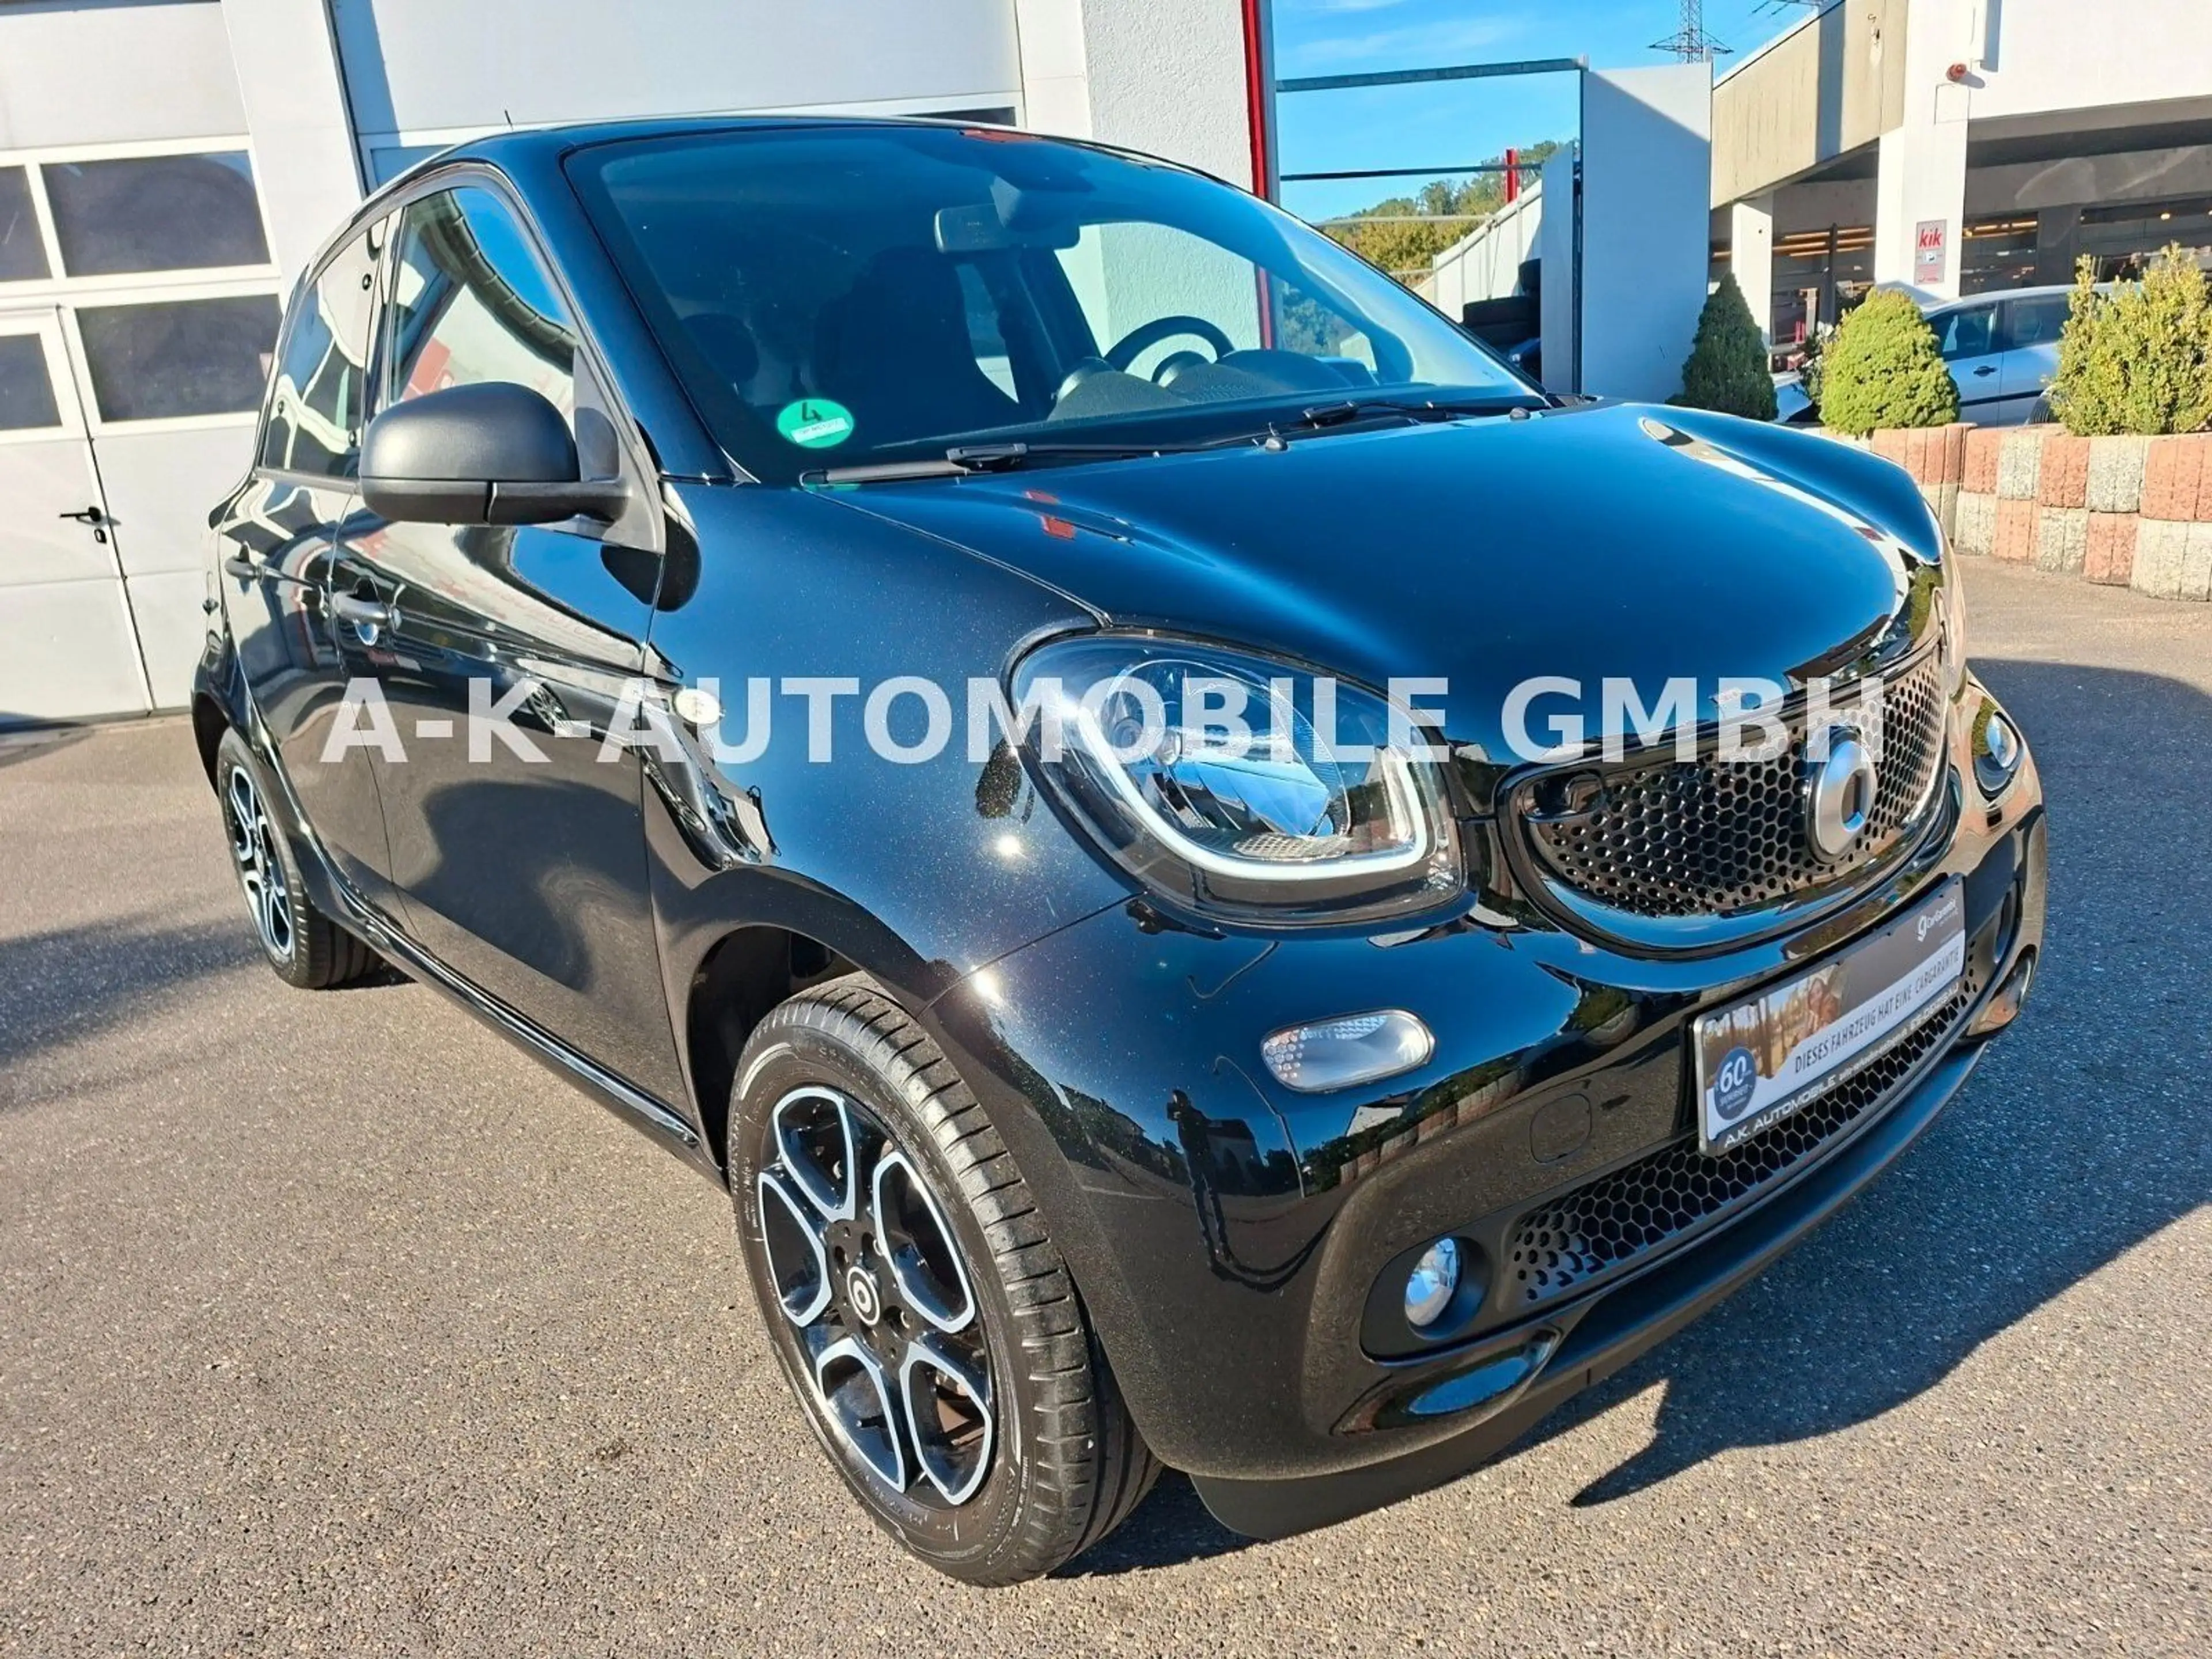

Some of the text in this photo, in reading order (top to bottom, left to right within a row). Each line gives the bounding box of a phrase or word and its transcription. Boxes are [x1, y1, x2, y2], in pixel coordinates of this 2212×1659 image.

[1919, 227, 1942, 248] kik
[801, 402, 823, 422] 4
[1794, 1037, 1829, 1073] DIESES
[1831, 1010, 1876, 1053] FAHRZEUG
[1878, 997, 1894, 1020] HAT
[1719, 1055, 1747, 1093] 60
[1753, 1074, 1837, 1132] AUTOMOBILE
